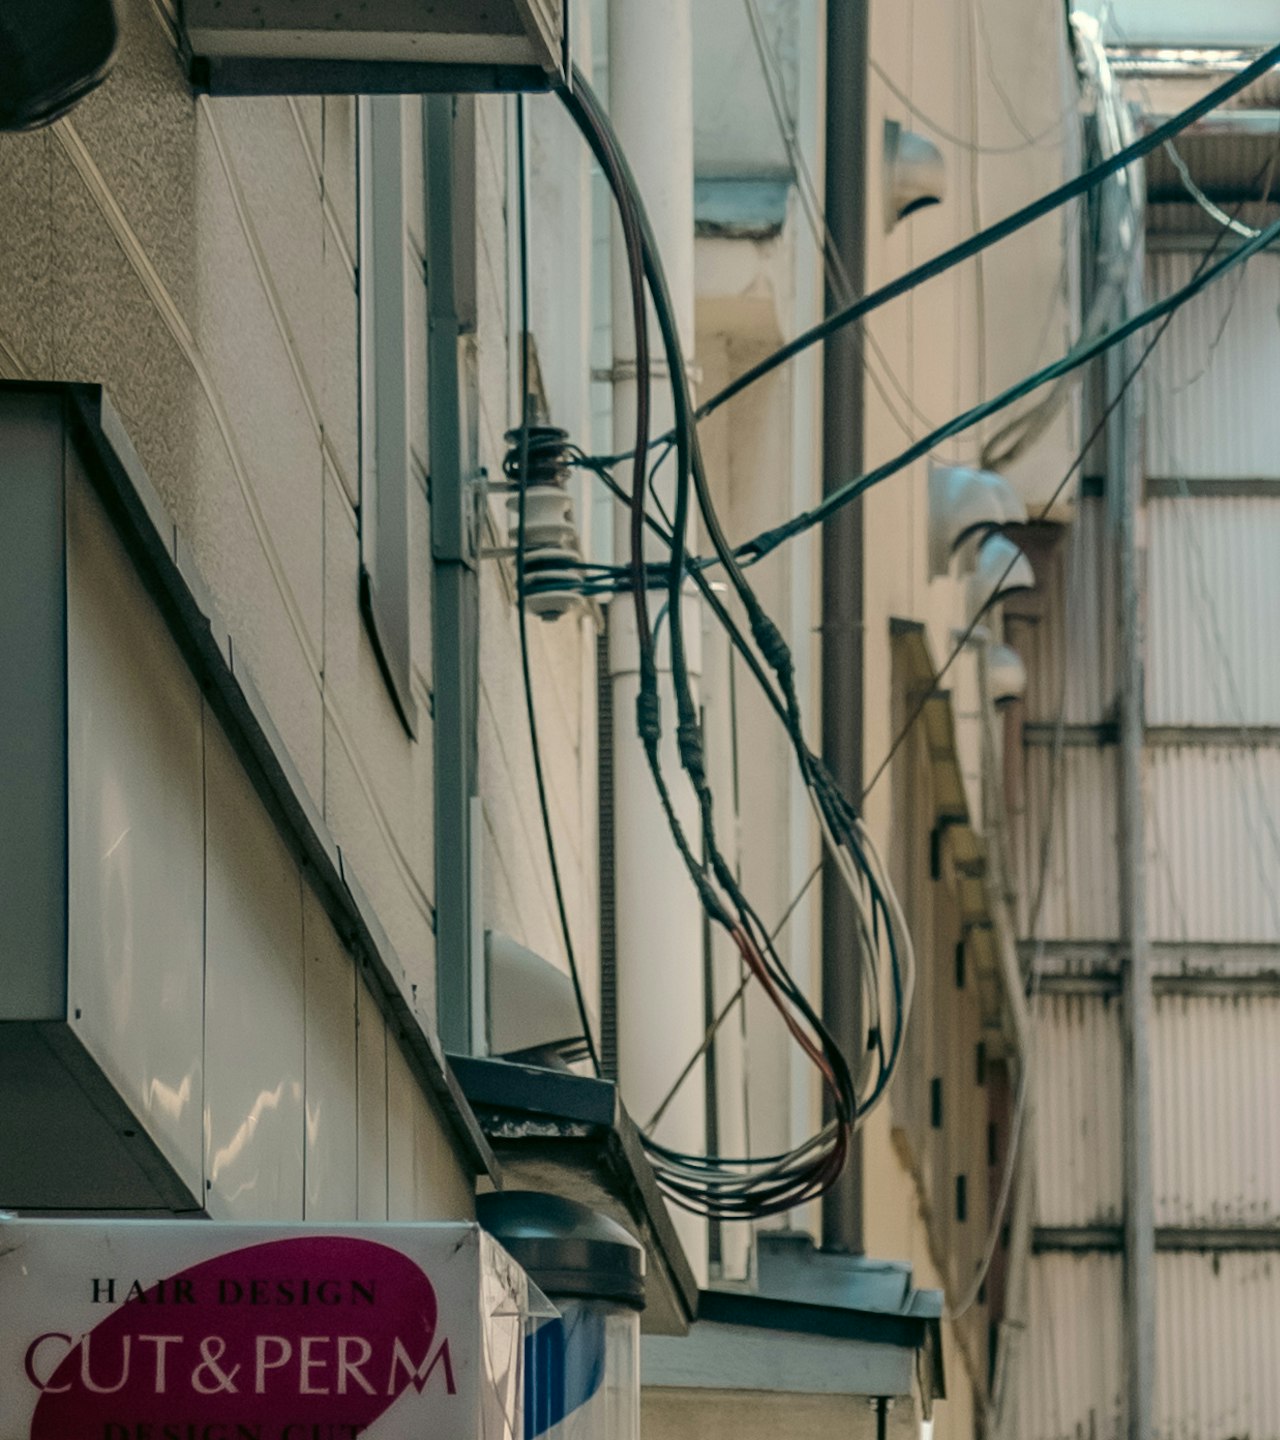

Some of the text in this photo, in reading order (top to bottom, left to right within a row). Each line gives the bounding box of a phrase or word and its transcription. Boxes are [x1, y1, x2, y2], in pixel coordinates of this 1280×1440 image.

[90, 1278, 378, 1306] HAIR DESIGN
[24, 1332, 457, 1396] CUT&PERM
